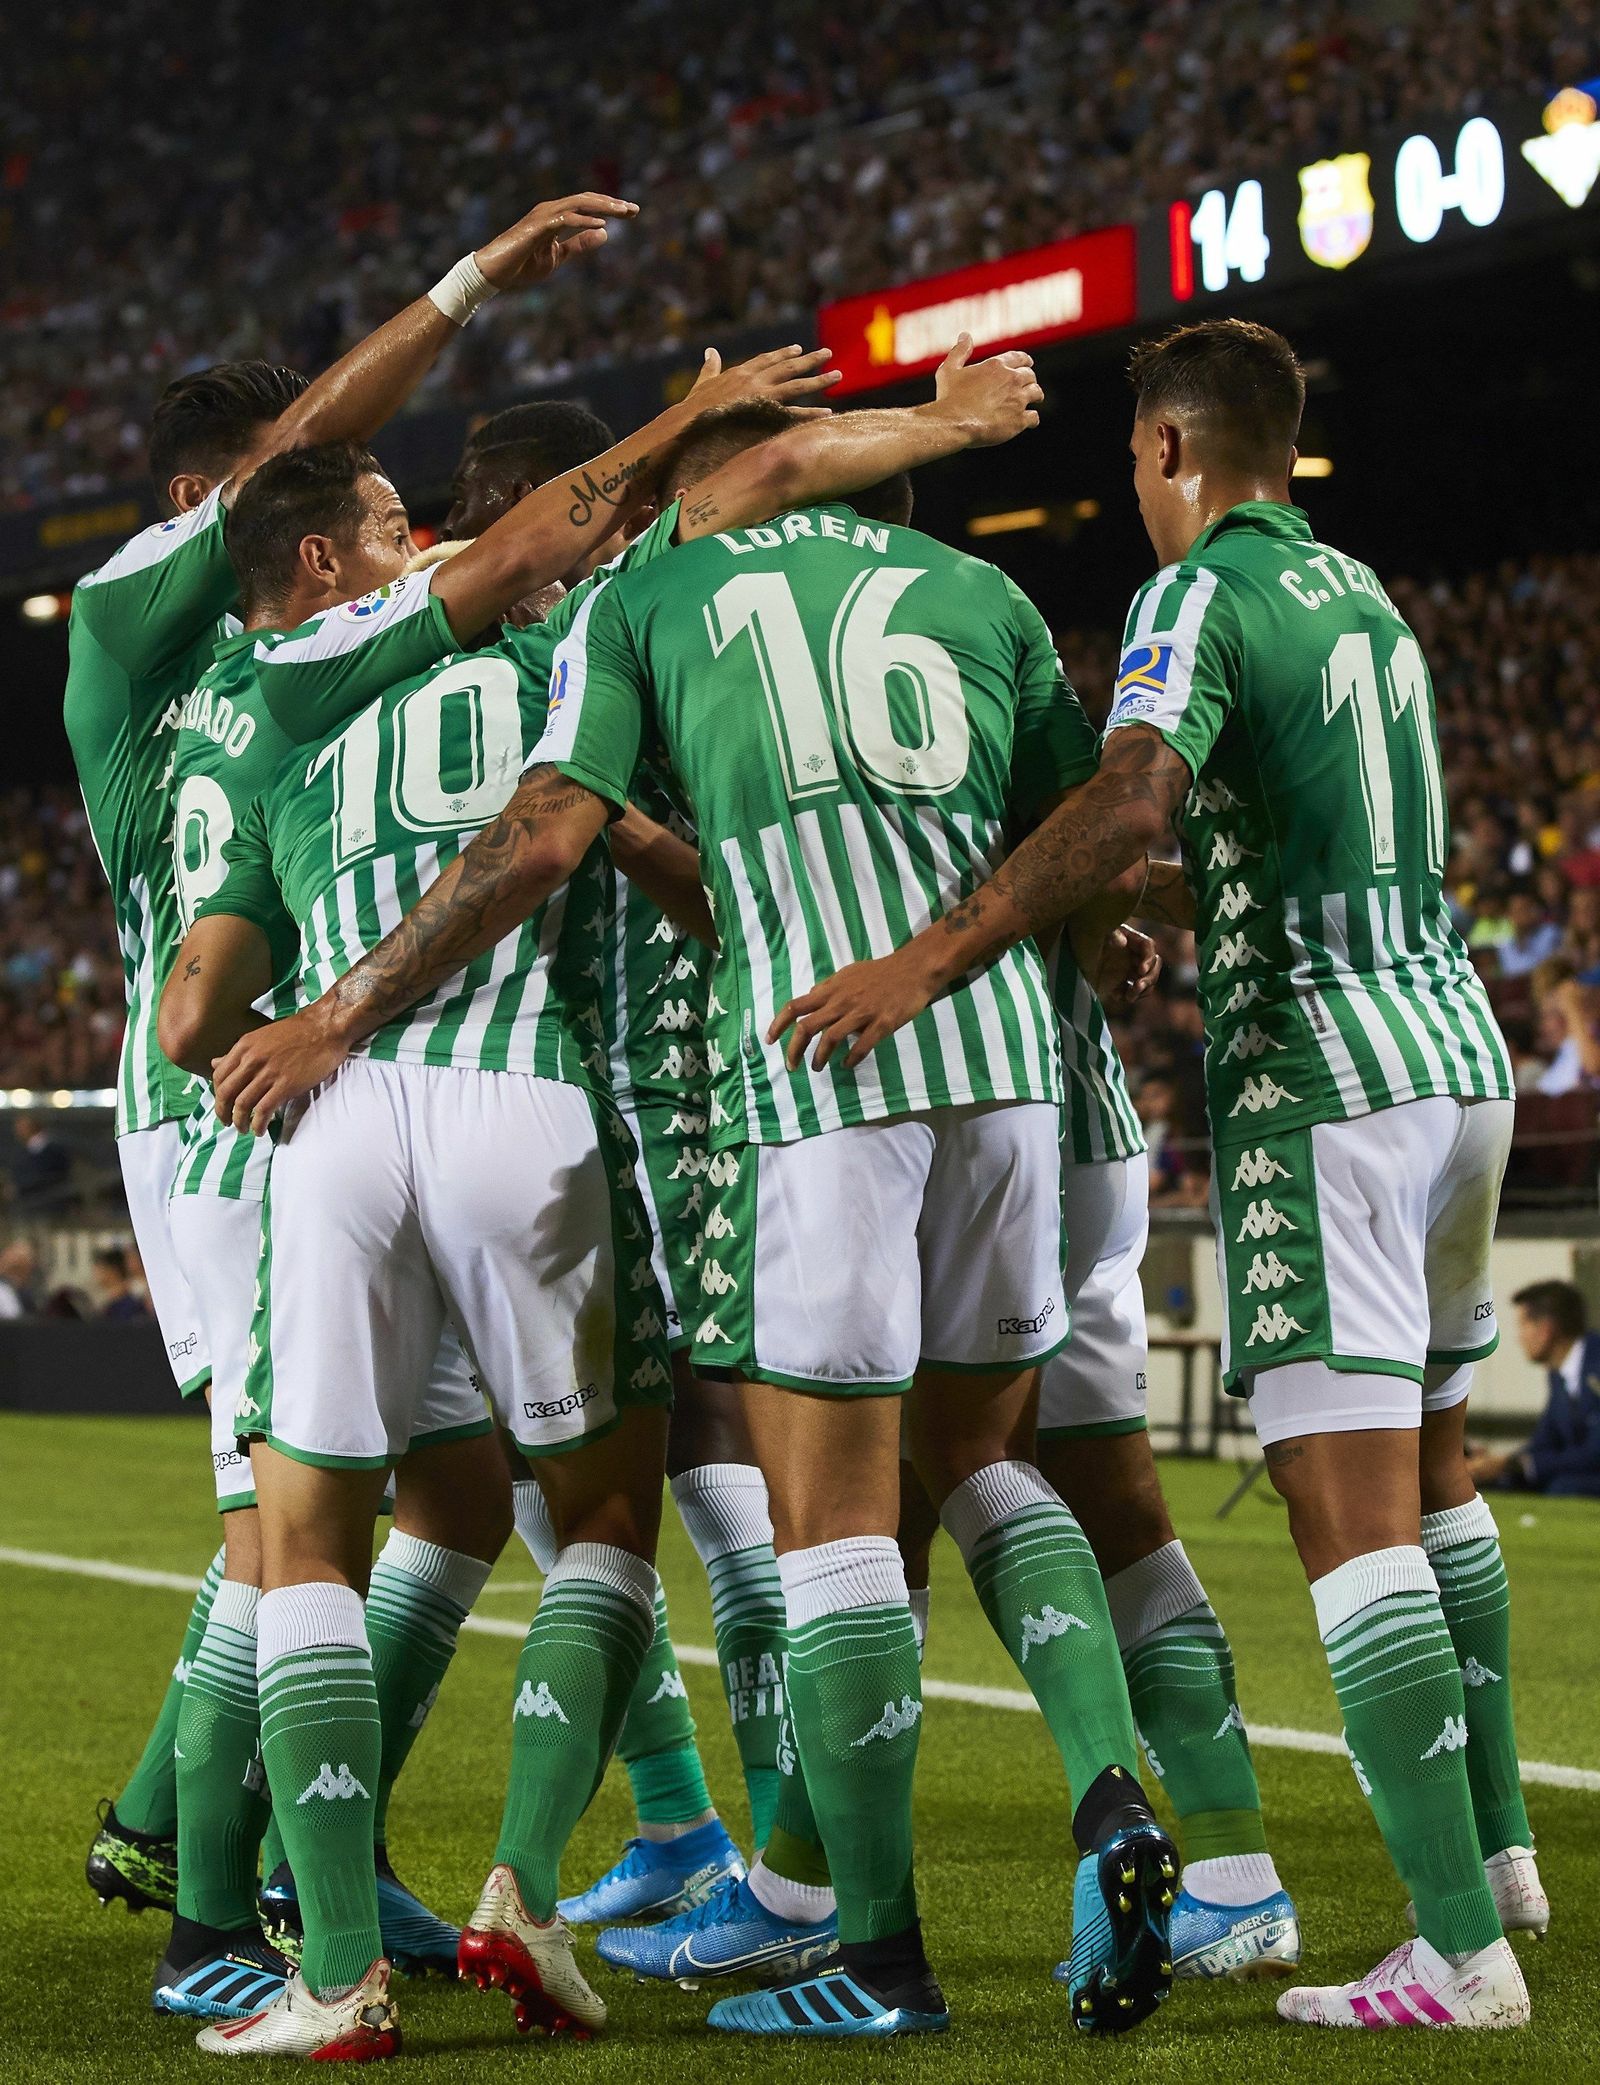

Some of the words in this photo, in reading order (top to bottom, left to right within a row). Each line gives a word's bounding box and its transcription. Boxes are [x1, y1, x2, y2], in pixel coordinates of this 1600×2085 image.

[1190, 179, 1270, 292] 14
[1395, 117, 1505, 243] 0-0
[713, 514, 890, 555] LOREN
[305, 657, 523, 873] 10
[703, 567, 970, 801] 16
[1321, 632, 1443, 877] 11
[523, 1383, 599, 1419] Kappa
